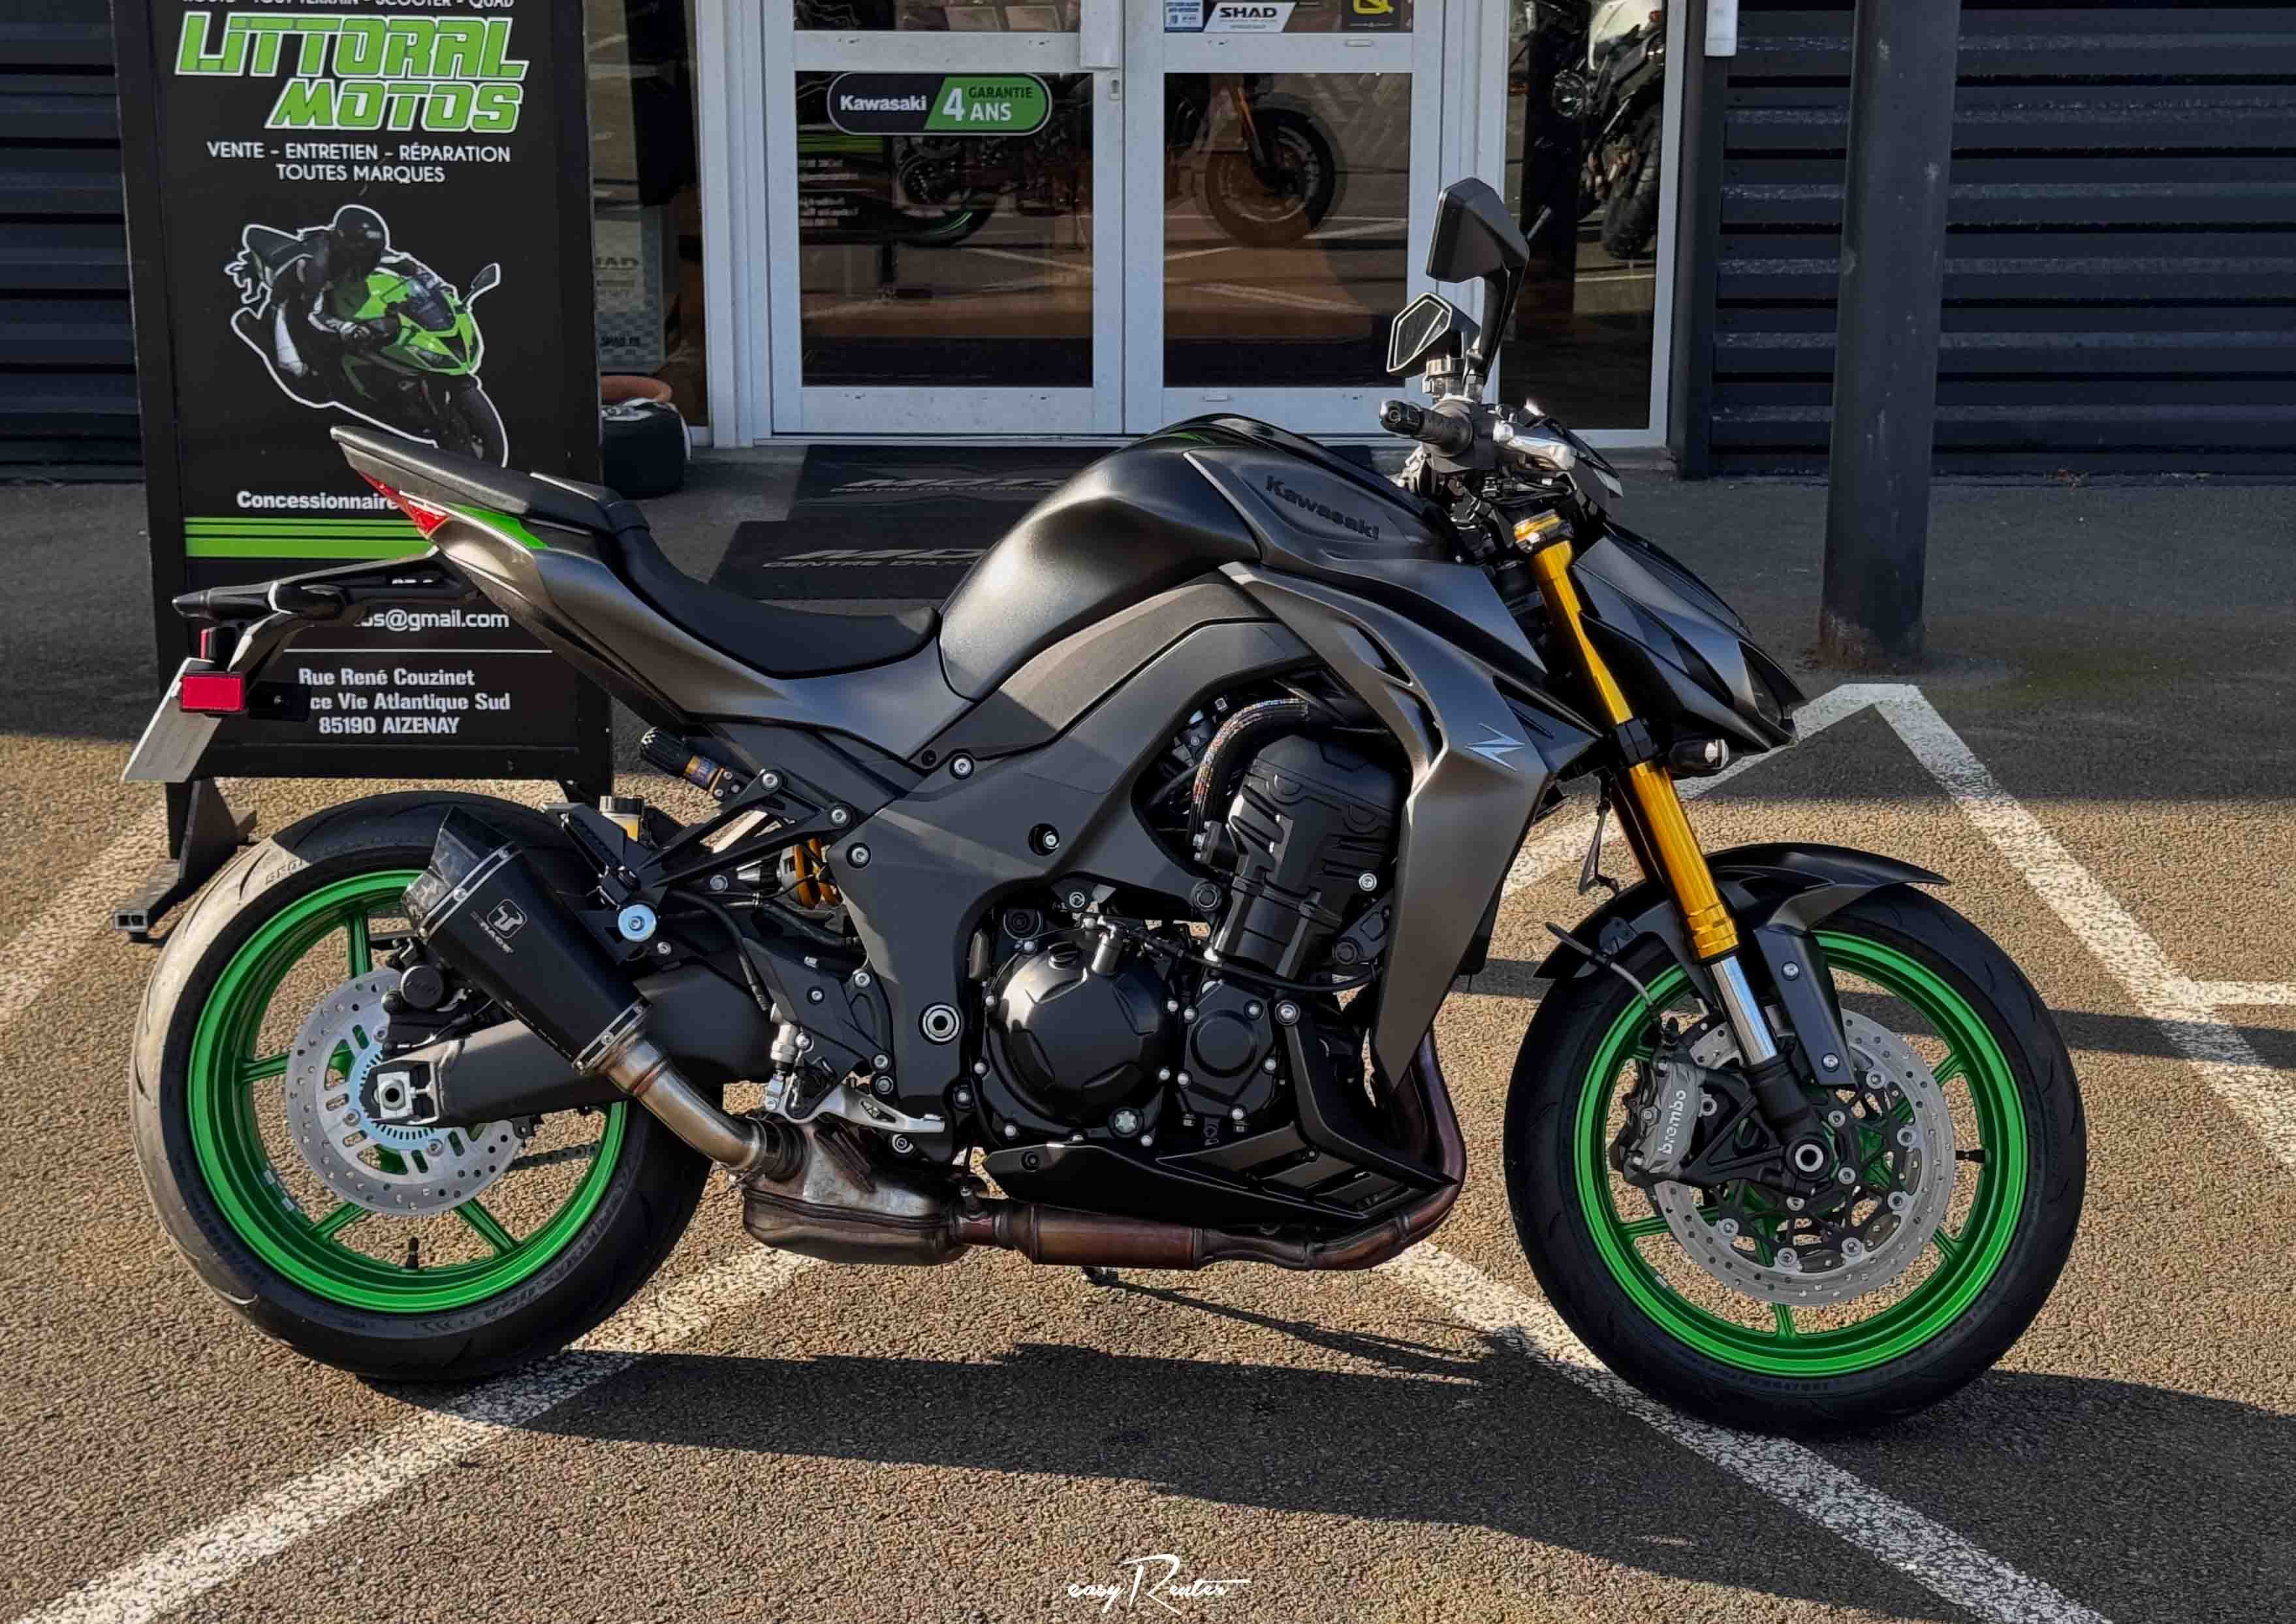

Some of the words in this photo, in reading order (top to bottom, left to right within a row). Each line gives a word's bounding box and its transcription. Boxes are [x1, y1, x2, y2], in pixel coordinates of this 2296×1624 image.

[1219, 7, 1278, 18] SHAD
[174, 11, 530, 80] LITTORAL
[840, 94, 928, 112] Kawasaki
[968, 86, 1033, 99] GARANTIE
[264, 78, 524, 133] MOTOS
[942, 88, 966, 122] 4
[969, 102, 1013, 122] ANS
[206, 141, 265, 159] VENTE
[285, 142, 379, 161] ENTRETIEN
[398, 142, 511, 163] RÉPARATION
[275, 163, 348, 182] TOUTES
[353, 165, 447, 185] MARQUES
[1265, 475, 1379, 540] Kawasaki
[298, 667, 336, 686] Rue
[340, 668, 389, 686] René
[393, 667, 476, 687] Couzinet
[337, 692, 368, 710] Vie
[373, 692, 470, 714] Atlantique
[475, 692, 511, 711] Sud
[319, 716, 377, 735] 85190
[382, 716, 460, 735] AIZENAY
[1658, 1090, 1686, 1154] brembo
